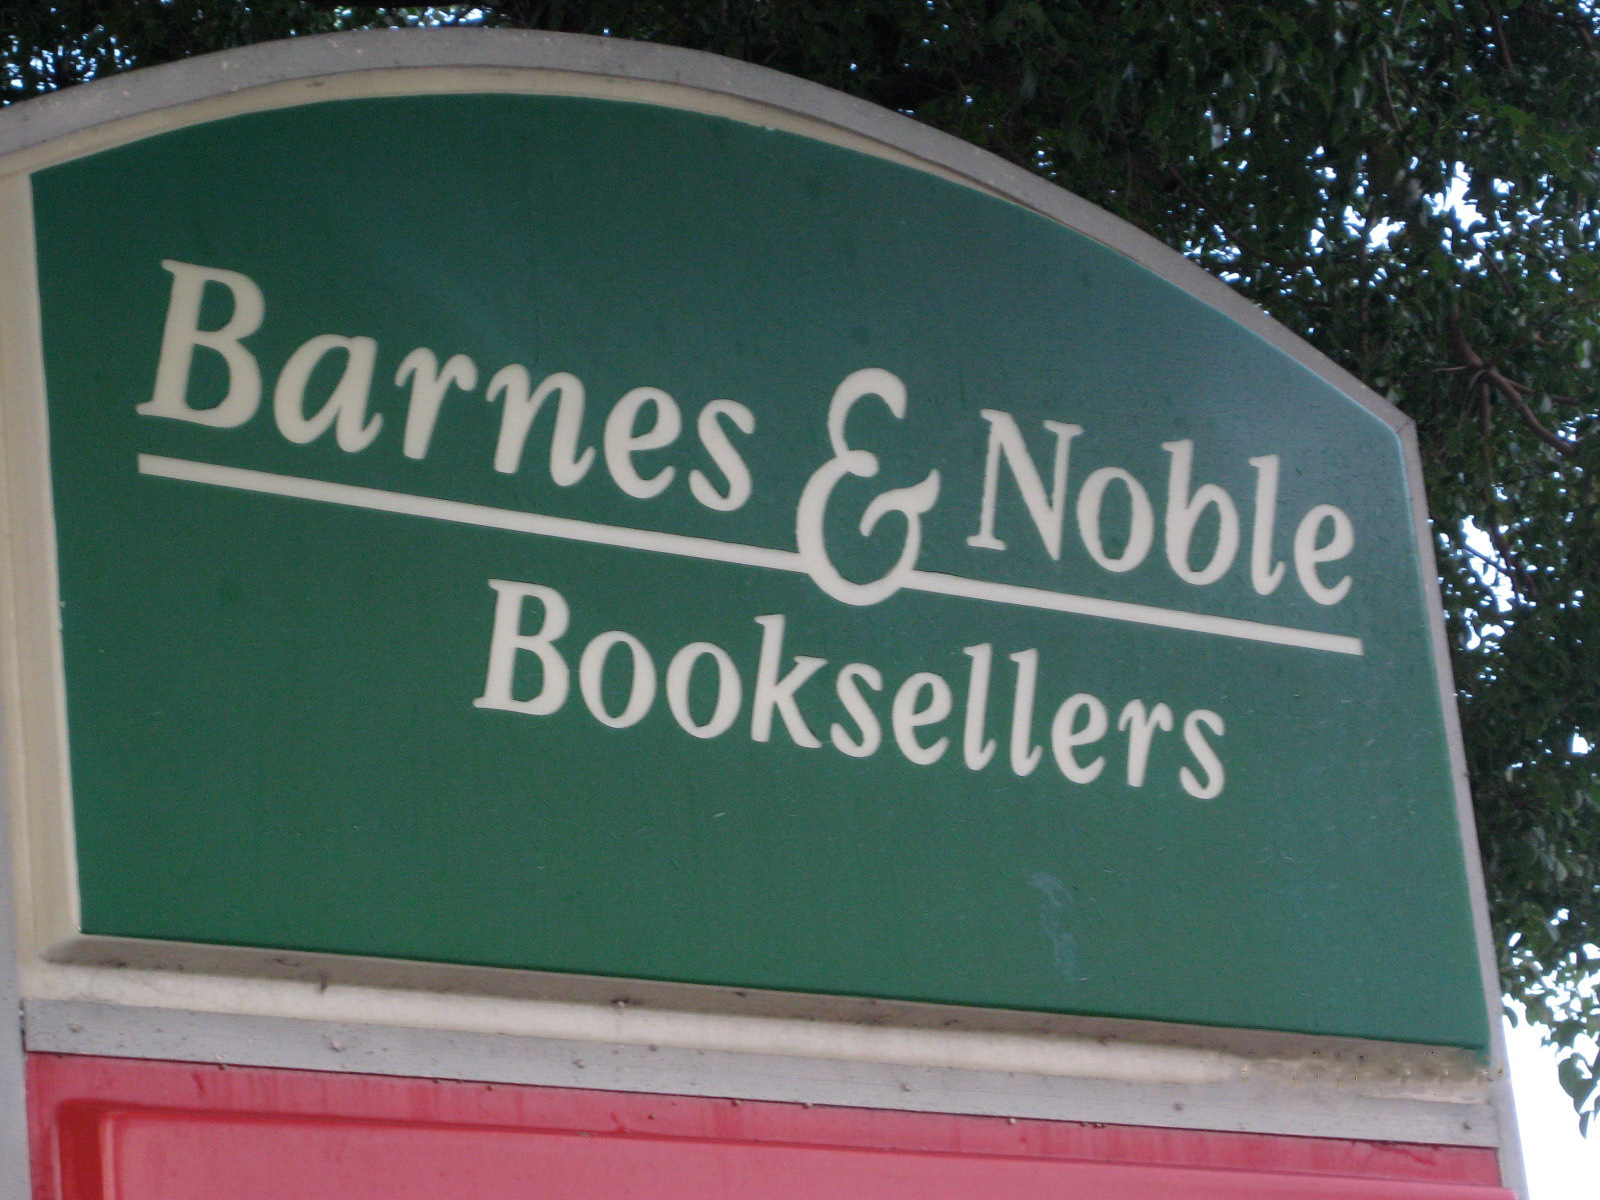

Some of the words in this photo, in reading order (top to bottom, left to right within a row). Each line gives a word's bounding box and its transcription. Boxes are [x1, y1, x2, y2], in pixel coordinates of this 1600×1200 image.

[136, 258, 755, 512] Barnes
[795, 367, 941, 607] &
[966, 408, 1355, 606] Noble
[473, 577, 1225, 800] Booksellers
